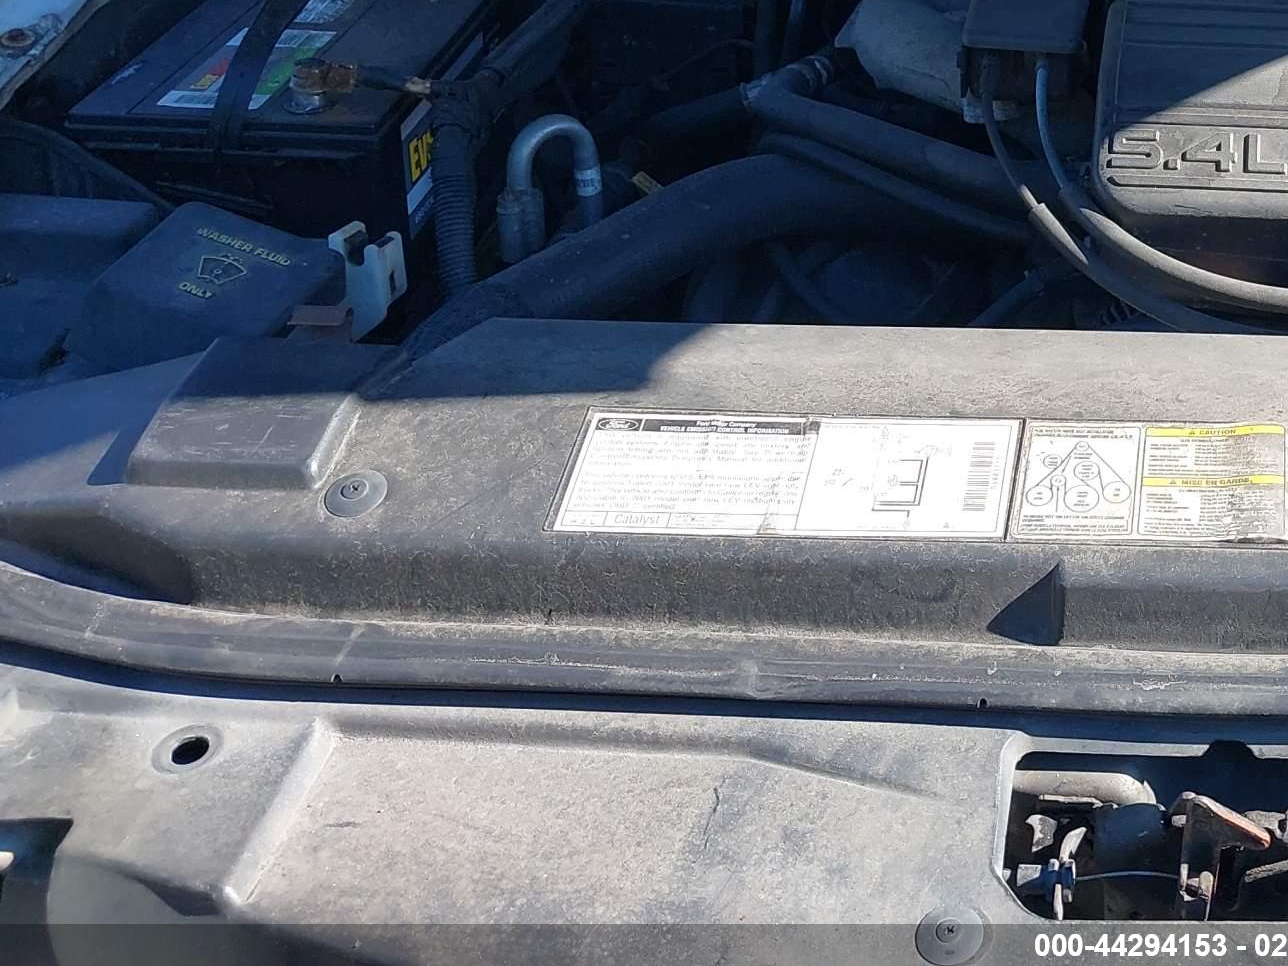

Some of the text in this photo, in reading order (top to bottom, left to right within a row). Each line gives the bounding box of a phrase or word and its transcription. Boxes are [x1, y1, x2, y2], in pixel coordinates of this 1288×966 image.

[1106, 130, 1287, 175] 5.4L
[195, 226, 292, 267] WASHER FLUID
[178, 280, 215, 300] ONLY
[728, 421, 757, 429] Company
[1199, 429, 1236, 437] CAUTION
[614, 514, 660, 527] Catalyst
